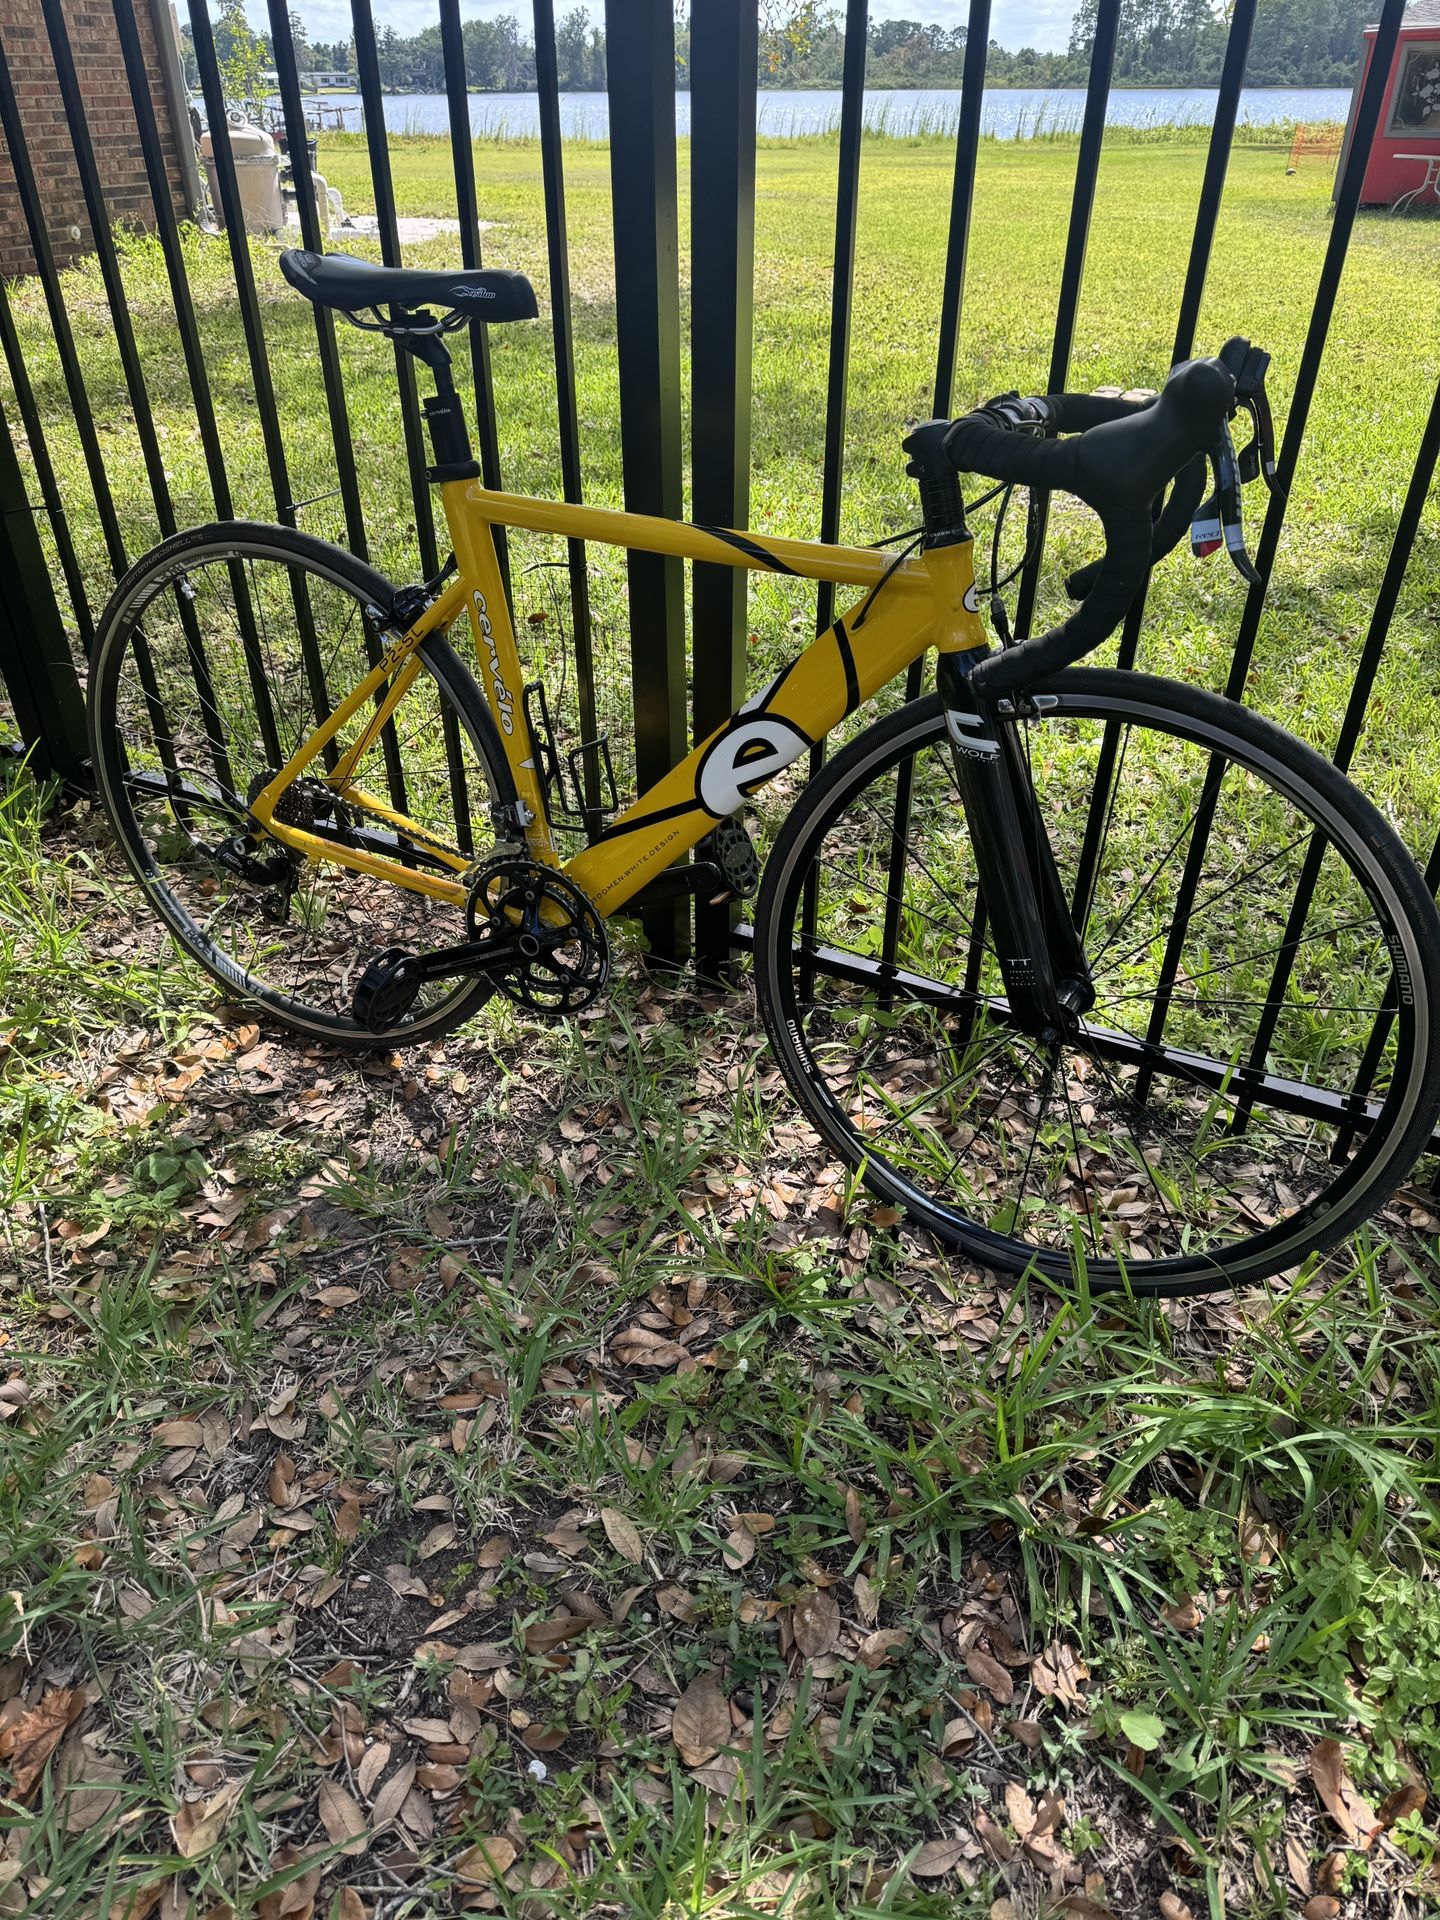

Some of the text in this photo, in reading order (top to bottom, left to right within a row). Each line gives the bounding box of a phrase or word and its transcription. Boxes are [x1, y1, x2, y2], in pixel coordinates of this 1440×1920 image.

[378, 627, 425, 673] P2-SL
[955, 744, 1001, 761] WOLF
[1387, 934, 1414, 1005] SHIMANO
[786, 1019, 814, 1074] SHIMANO
